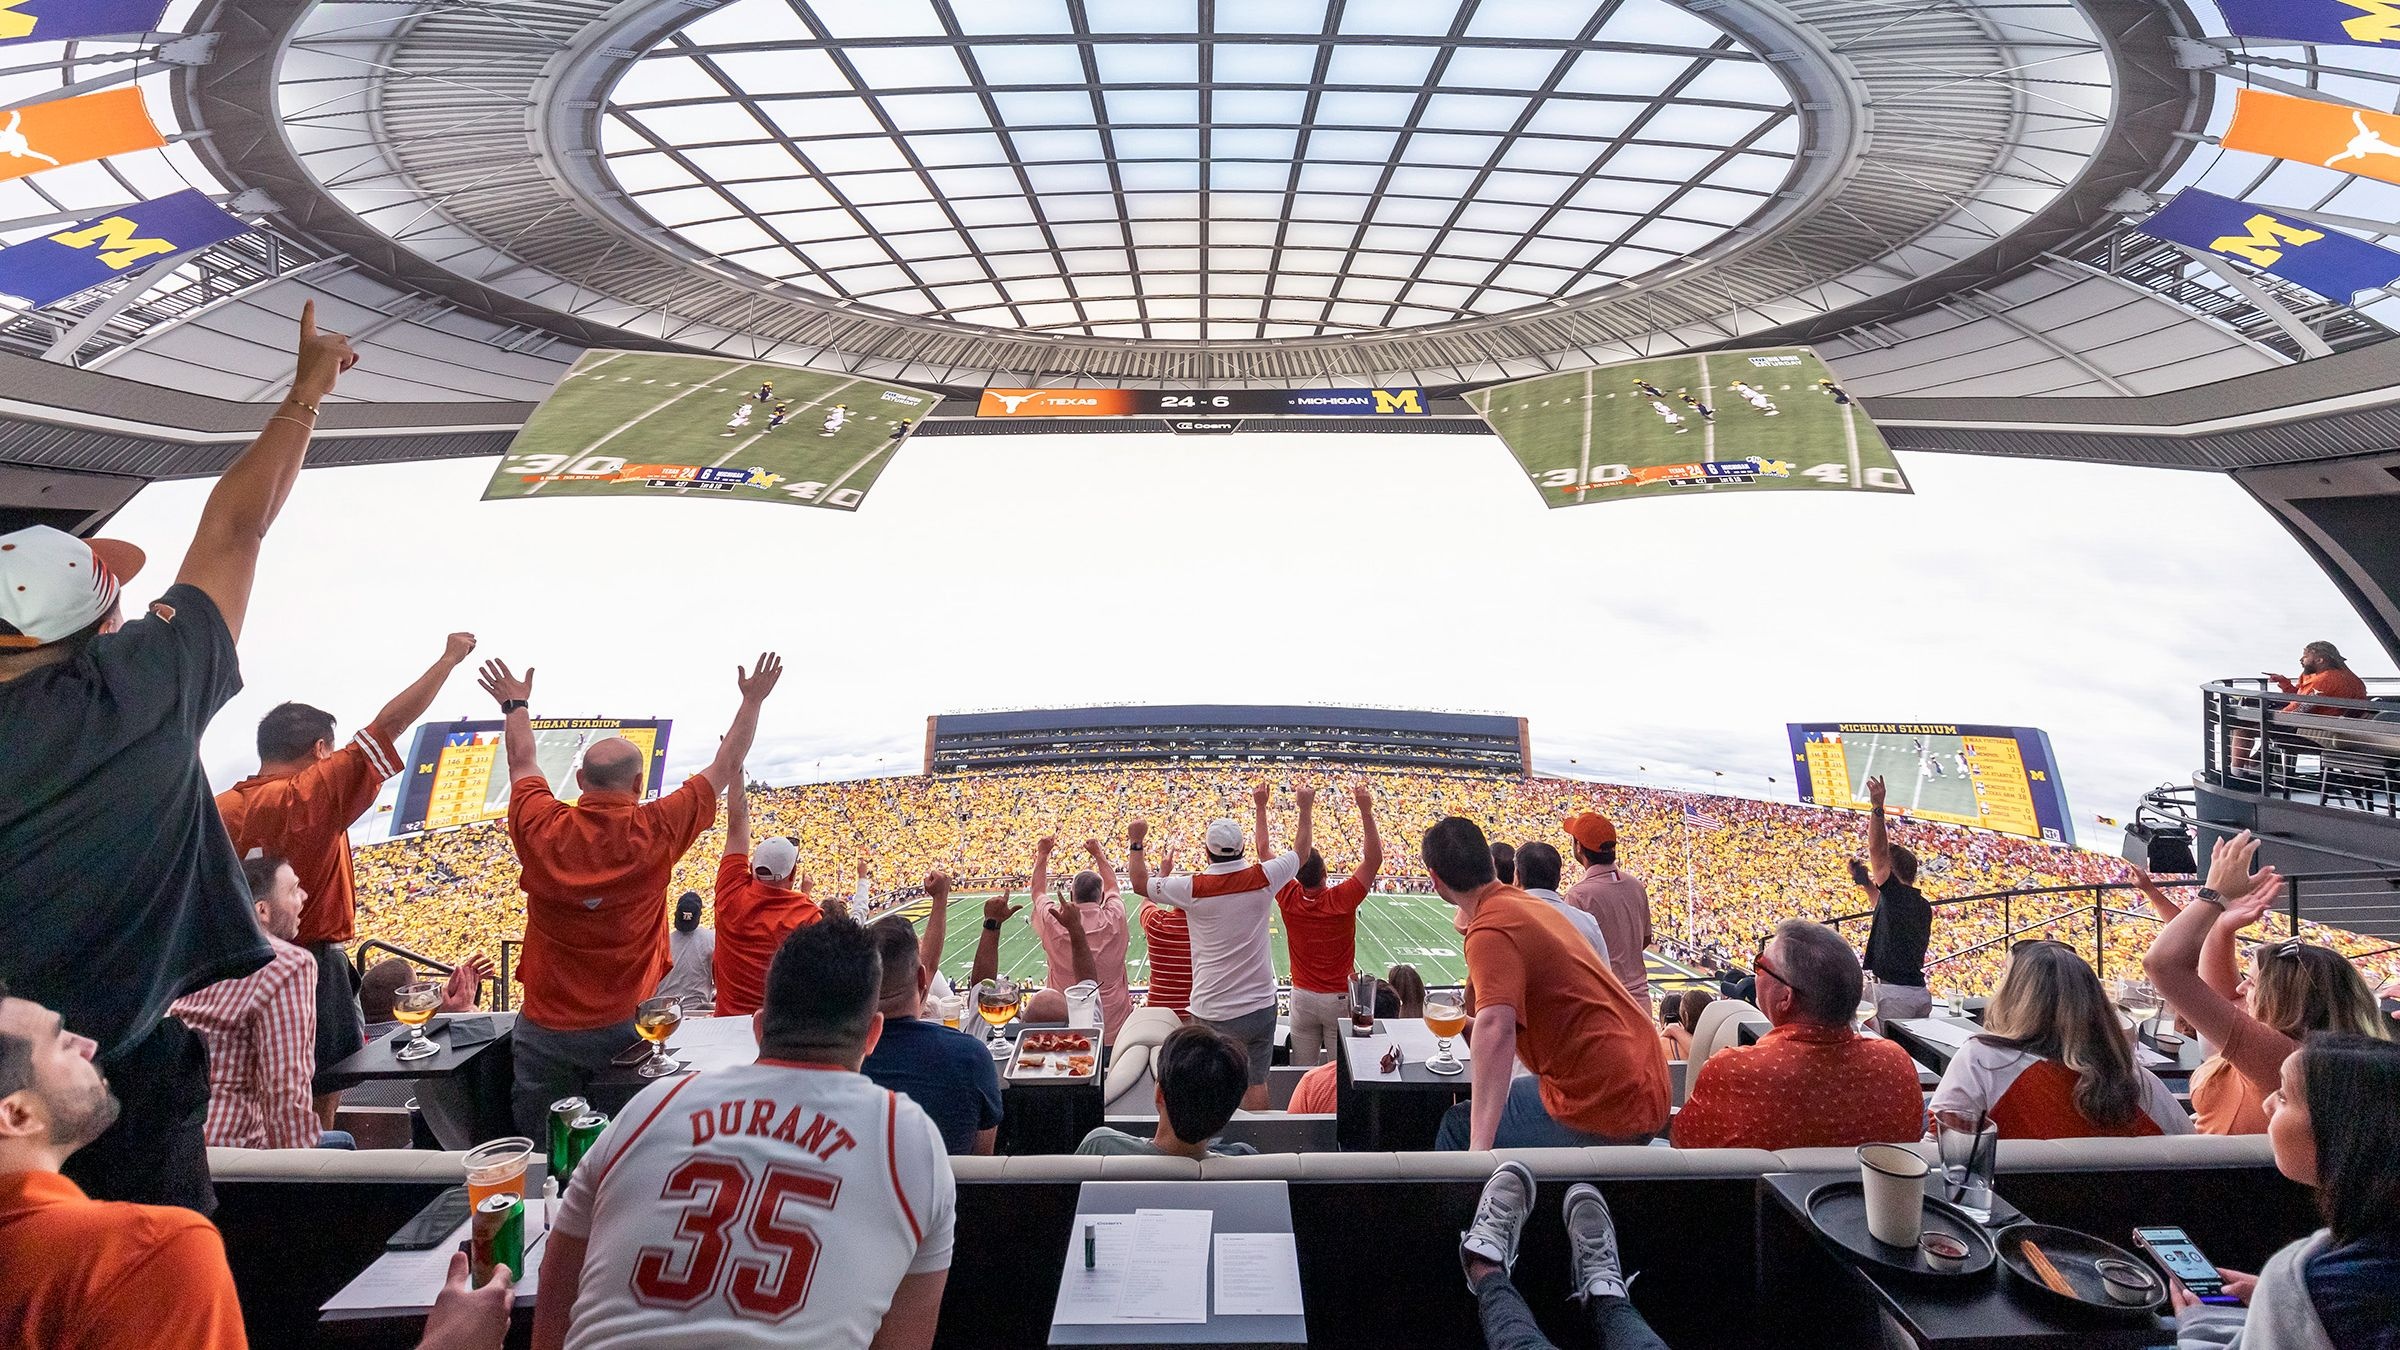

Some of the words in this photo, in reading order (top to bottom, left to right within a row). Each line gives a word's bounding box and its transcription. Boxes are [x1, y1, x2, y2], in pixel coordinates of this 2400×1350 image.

[1047, 398, 1098, 406] TEXAS
[1160, 396, 1196, 407] 24
[1212, 396, 1230, 407] 6
[1298, 397, 1369, 405] MICHIGAN
[678, 467, 697, 479] 24
[701, 468, 712, 480] 6
[1686, 464, 1703, 476] 24
[1706, 463, 1719, 475] 6
[531, 720, 569, 729] HIGAN
[571, 720, 621, 728] STADIUM
[1840, 724, 1896, 733] MICHIGAN
[1899, 726, 1958, 735] STADIUM
[689, 1098, 857, 1163] DURANT
[629, 1152, 843, 1325] 35
